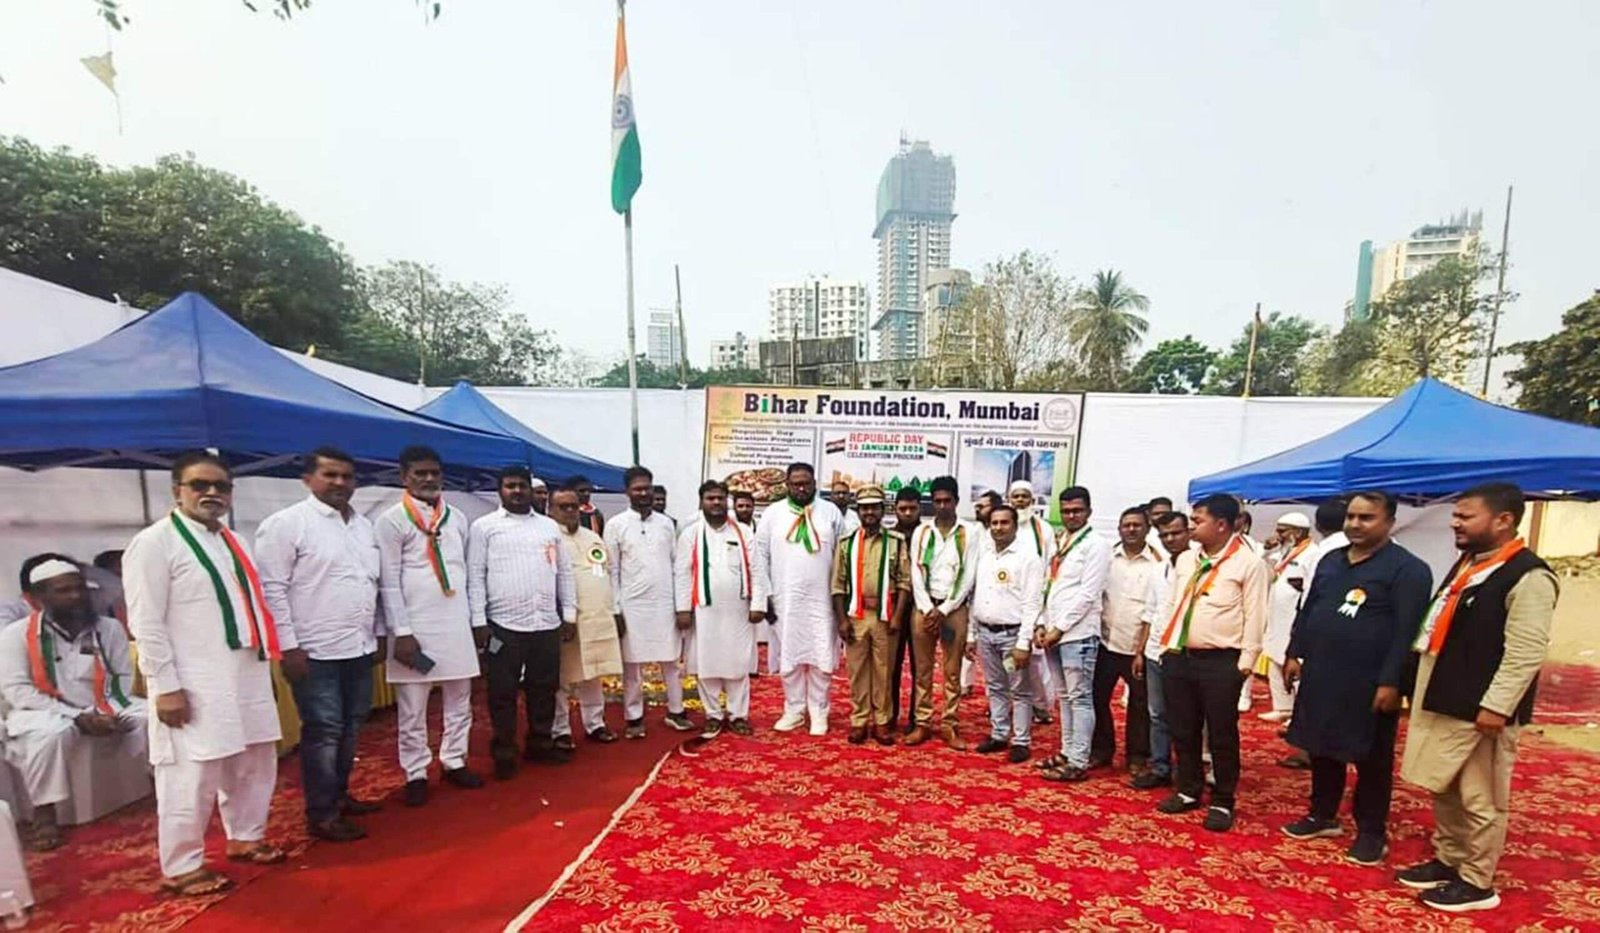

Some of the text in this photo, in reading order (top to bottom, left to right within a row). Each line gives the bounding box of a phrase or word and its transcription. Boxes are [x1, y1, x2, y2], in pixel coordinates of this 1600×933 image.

[744, 393, 1039, 421] Bihar Foundation, Mumbai
[849, 432, 925, 444] REPUBLIC DAY
